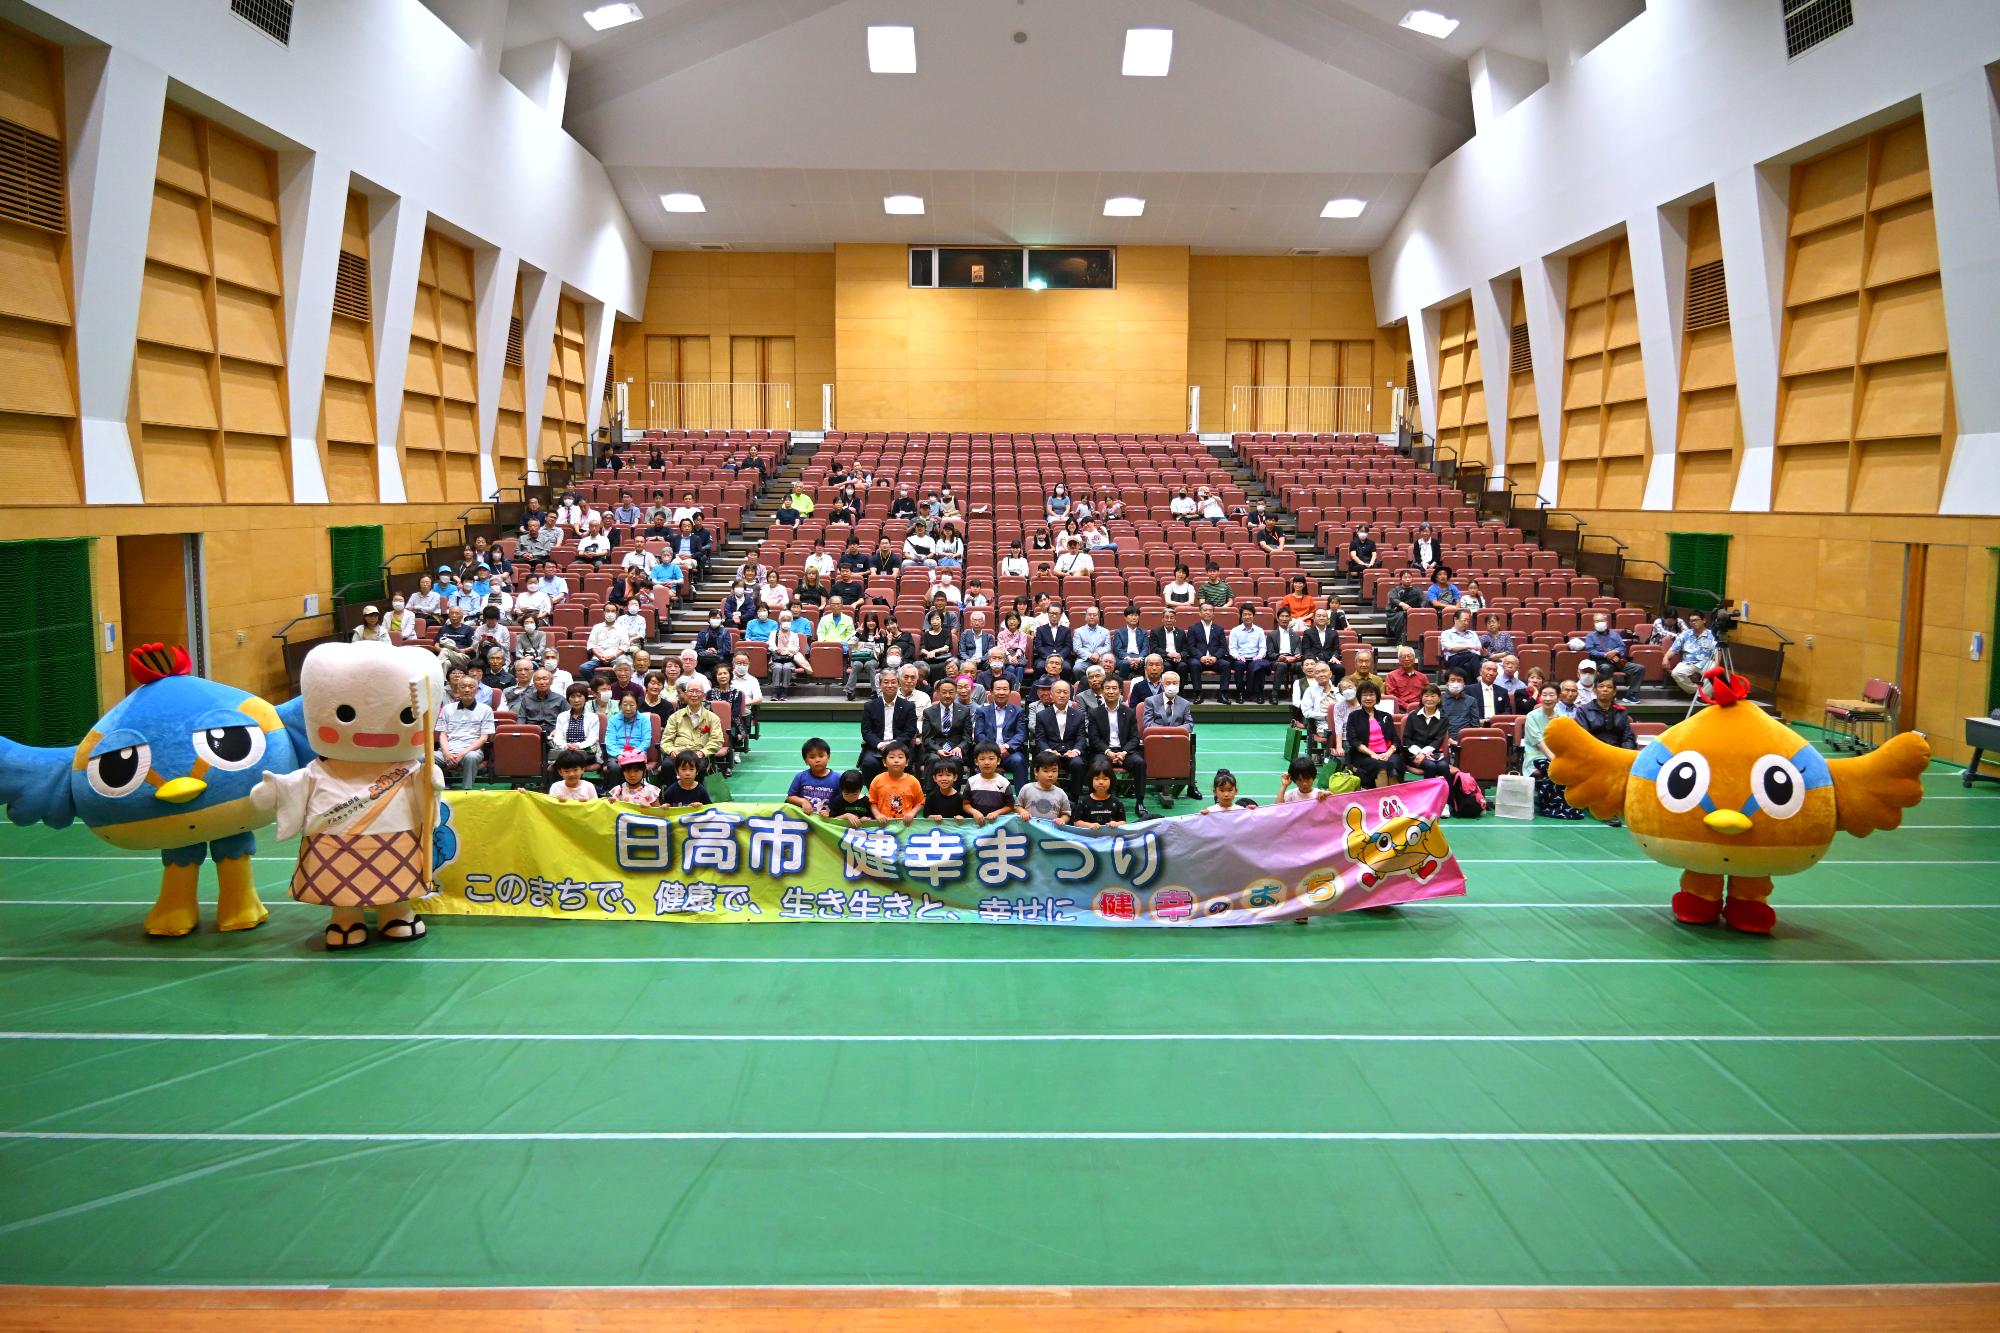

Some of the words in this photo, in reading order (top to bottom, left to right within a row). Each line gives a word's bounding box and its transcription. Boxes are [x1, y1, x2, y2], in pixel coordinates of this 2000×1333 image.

[616, 808, 809, 878] 日高市
[838, 826, 1160, 889] 健幸まつり
